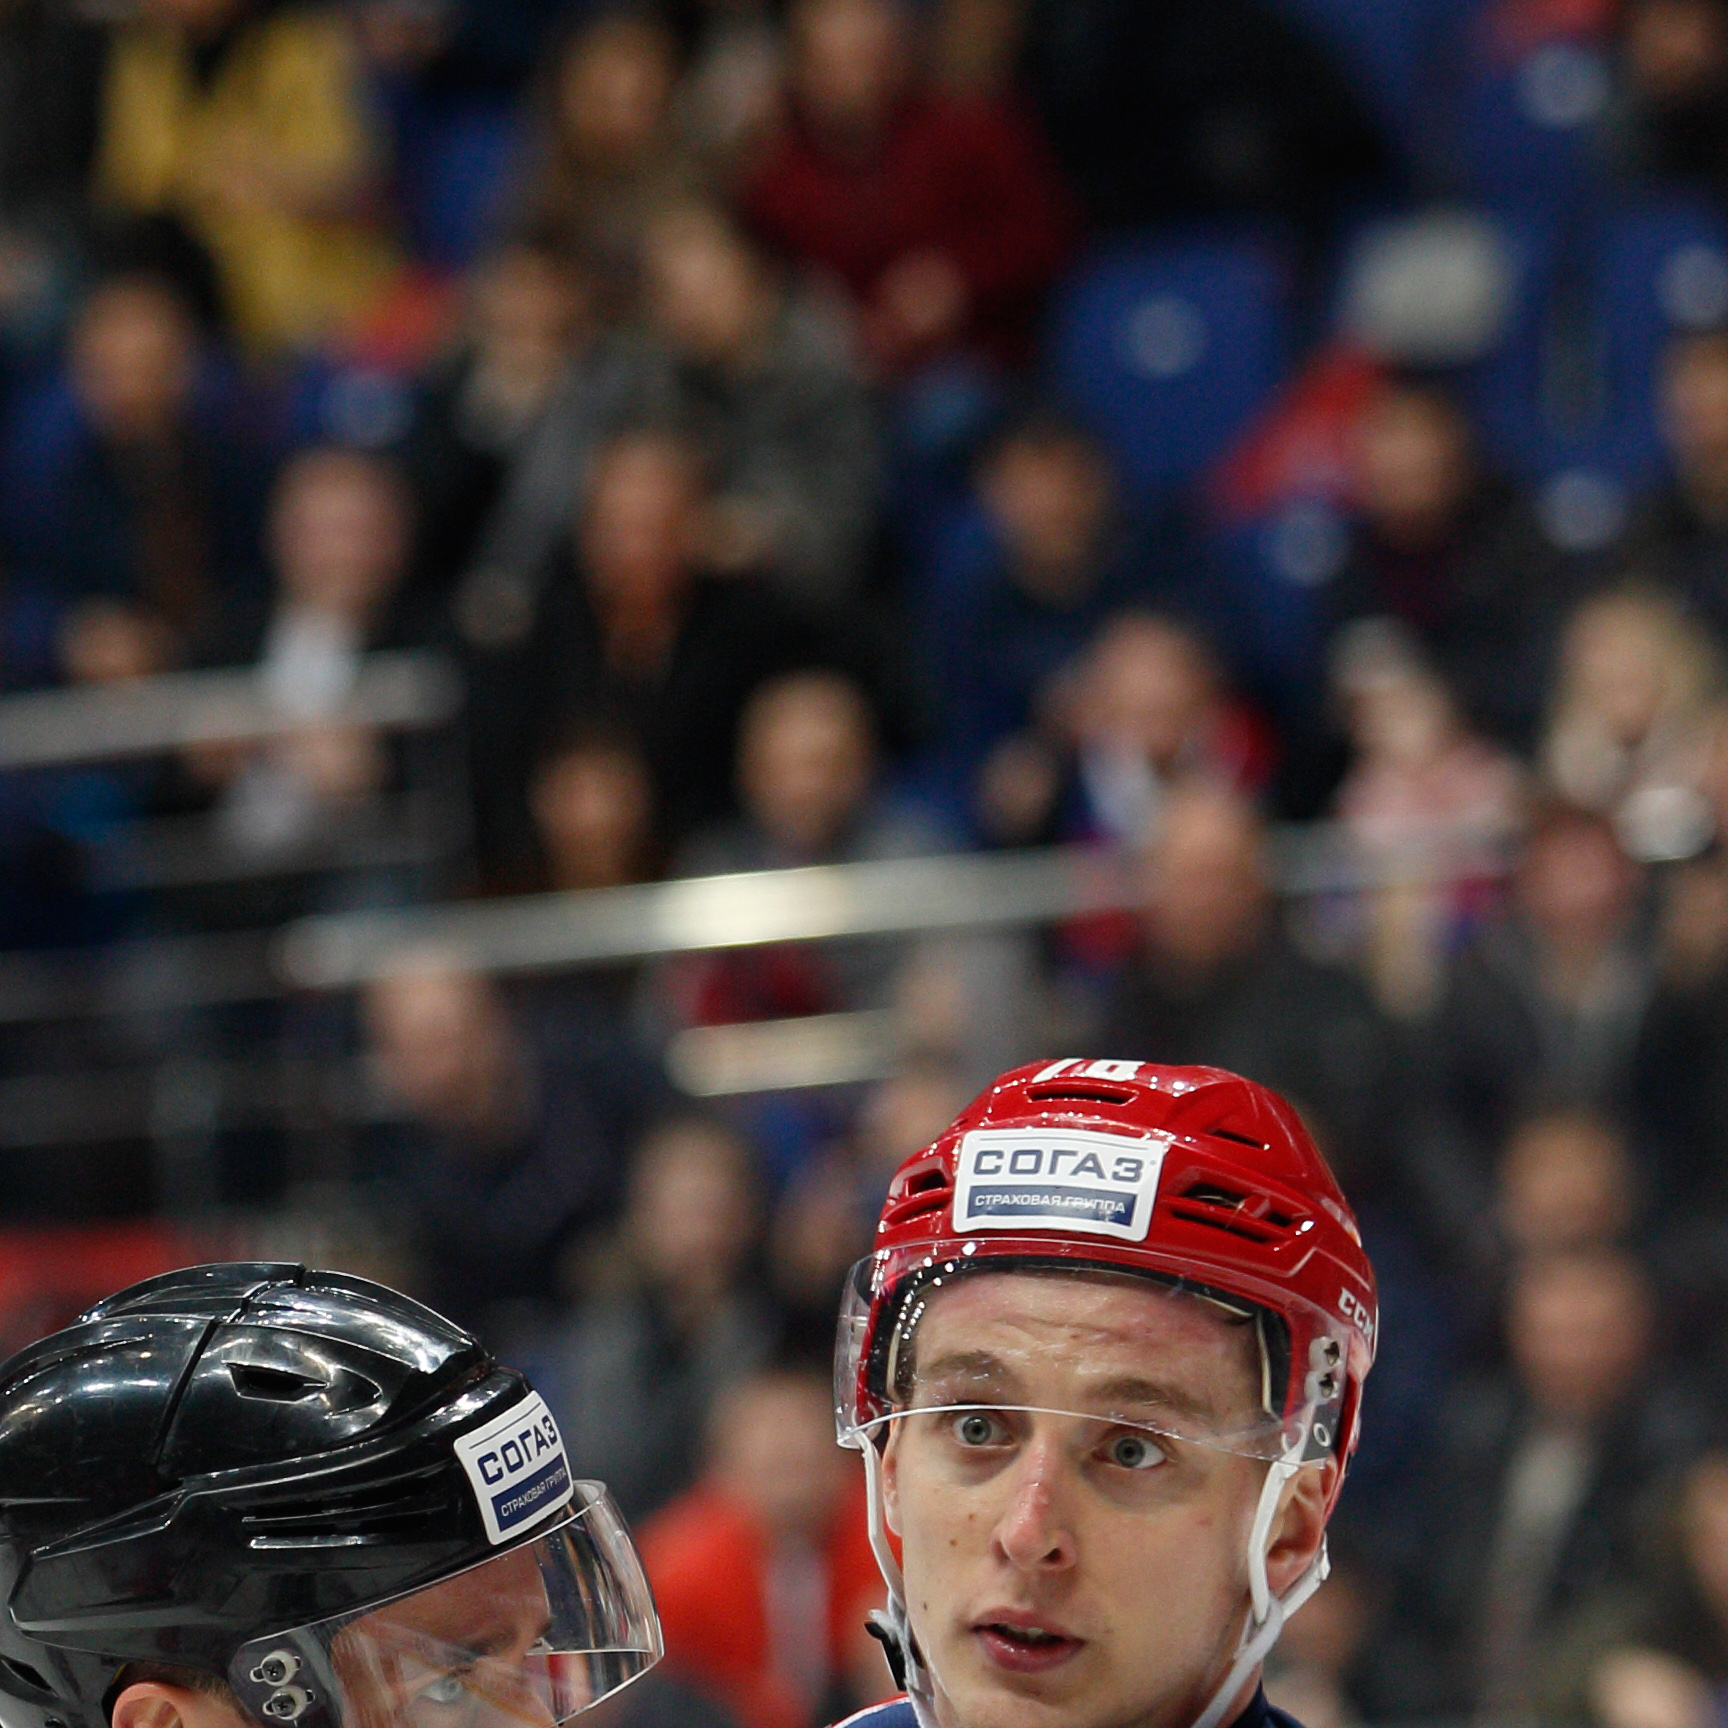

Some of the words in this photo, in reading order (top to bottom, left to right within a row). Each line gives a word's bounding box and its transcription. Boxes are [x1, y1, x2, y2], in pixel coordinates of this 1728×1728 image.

[972, 1149, 1145, 1183] СОГАЗ
[974, 1193, 1061, 1208] СТРАХОВАЯ
[476, 1414, 559, 1486] СОГАЗ
